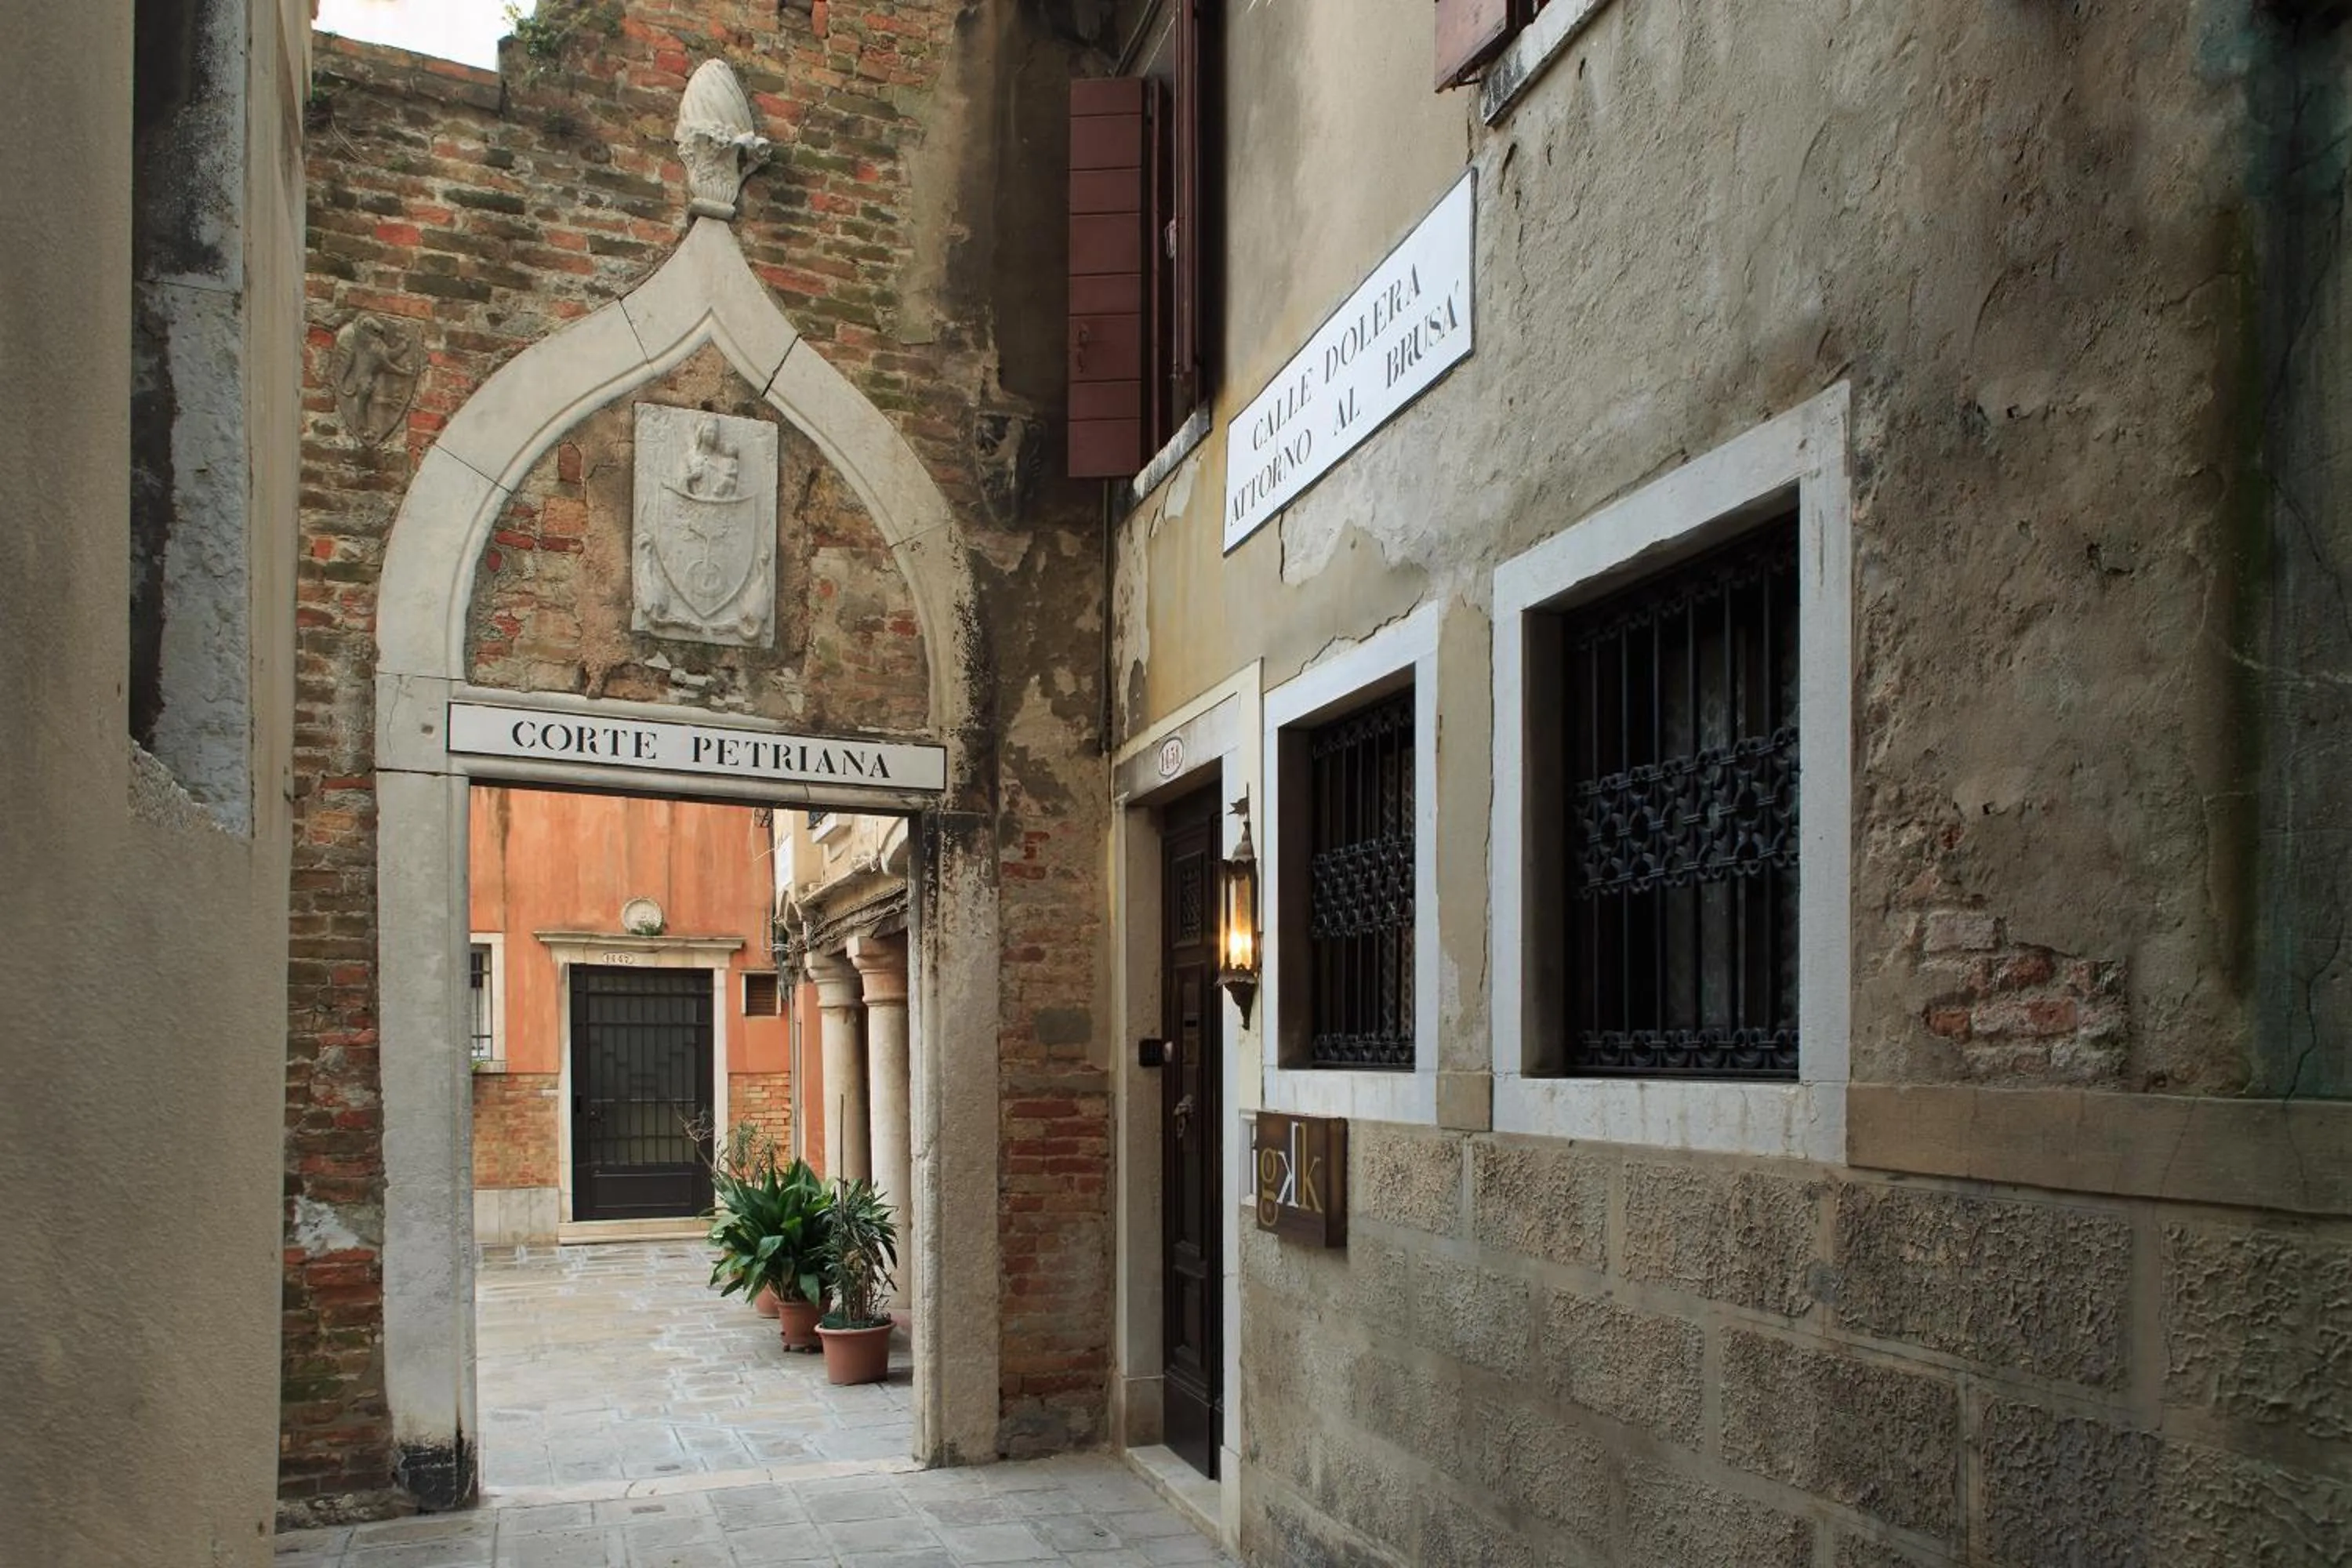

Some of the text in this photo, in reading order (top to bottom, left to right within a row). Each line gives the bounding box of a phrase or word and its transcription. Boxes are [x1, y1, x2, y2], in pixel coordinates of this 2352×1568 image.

[1252, 263, 1421, 452] CALLE DOLERA
[1229, 427, 1312, 527] ATTORNO
[1332, 386, 1361, 437] AL
[511, 720, 891, 779] CORTE PETRIANA
